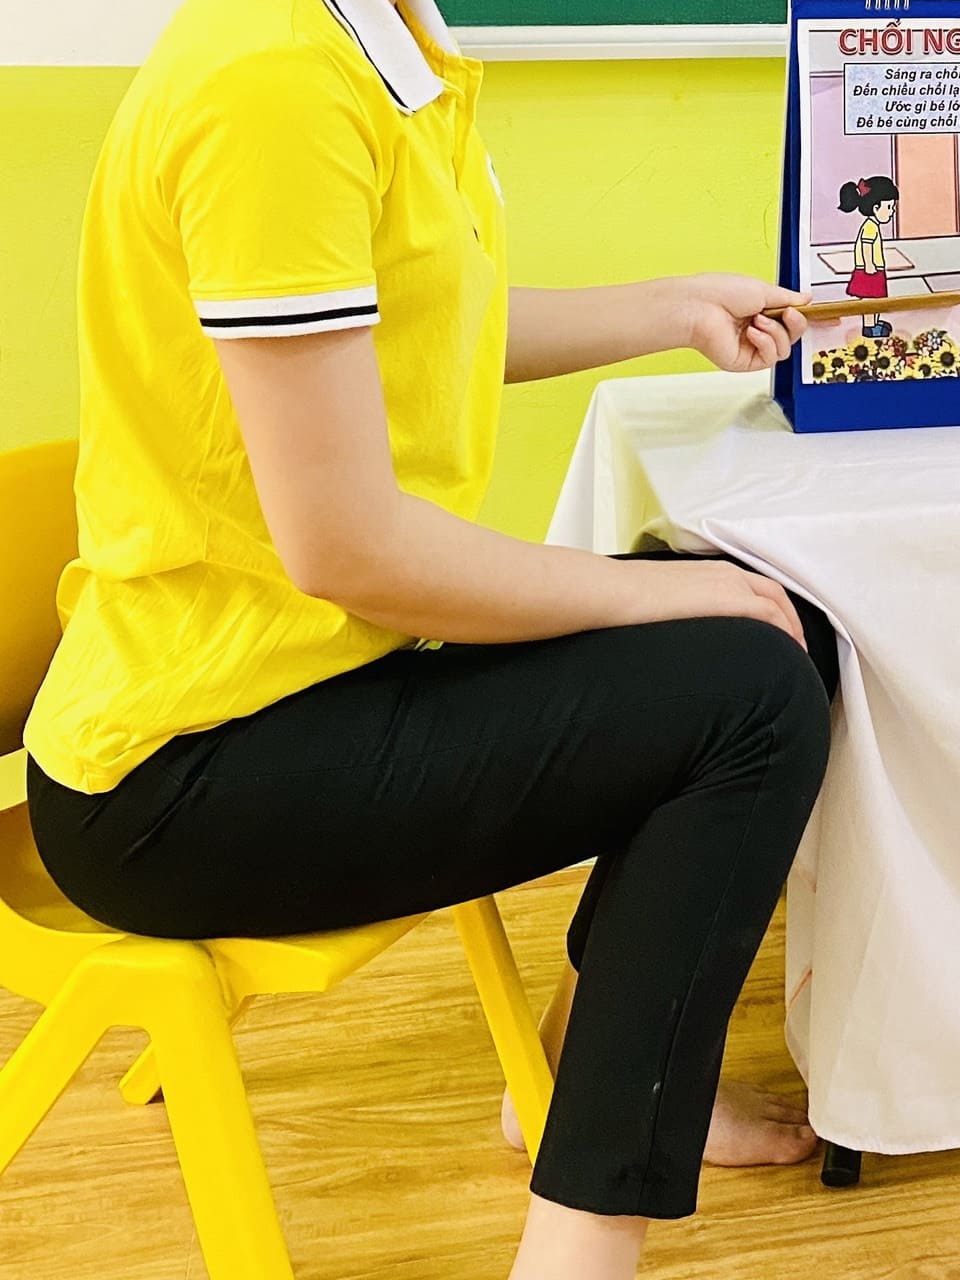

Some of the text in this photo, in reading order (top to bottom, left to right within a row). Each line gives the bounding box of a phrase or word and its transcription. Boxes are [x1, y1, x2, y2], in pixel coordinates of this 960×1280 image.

[839, 18, 913, 56] CHỔI
[885, 68, 916, 82] Sáng
[920, 70, 932, 79] ra
[853, 83, 878, 96] Đến
[881, 82, 916, 95] chiều
[919, 82, 946, 95] chổi
[885, 100, 912, 111] Ước
[930, 100, 945, 111] bé
[857, 115, 873, 127] Để
[877, 116, 893, 127] bé
[896, 116, 927, 129] cùng
[930, 114, 957, 127] chổi
